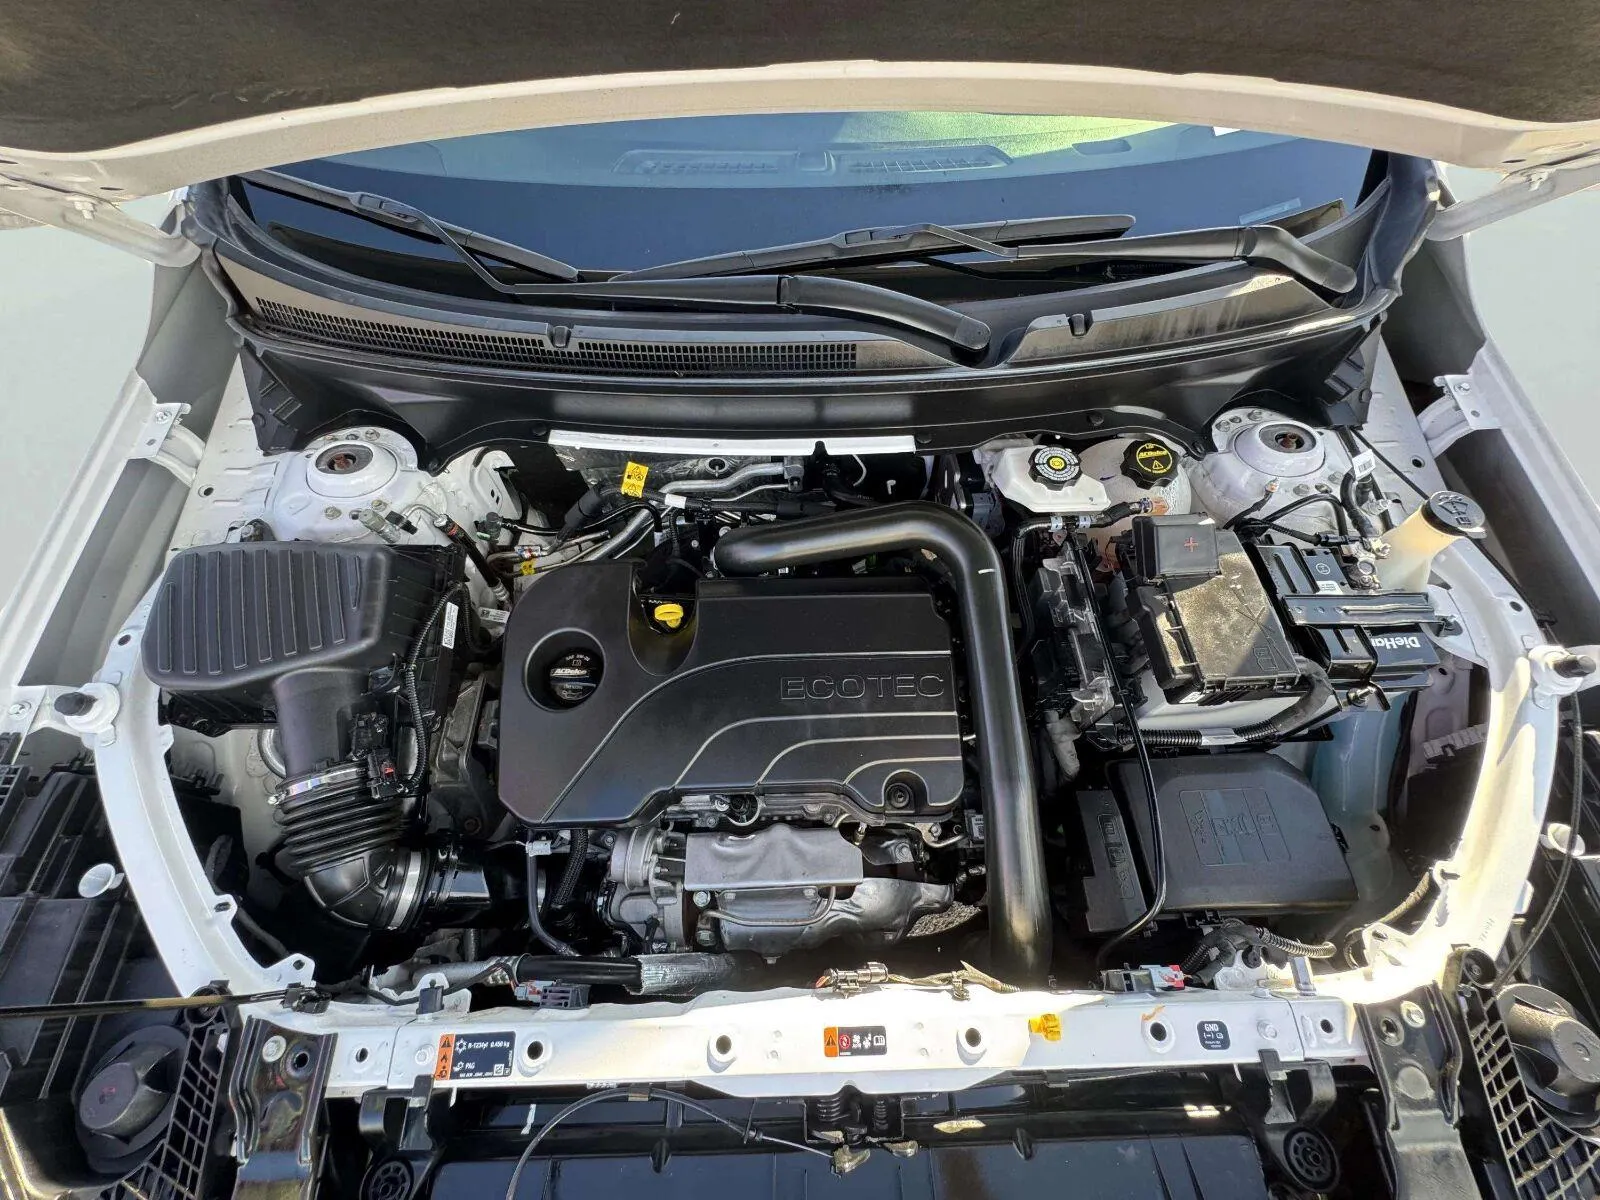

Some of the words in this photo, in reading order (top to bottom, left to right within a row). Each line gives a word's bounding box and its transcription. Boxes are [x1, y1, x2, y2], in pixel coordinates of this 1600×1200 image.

[1371, 636, 1421, 649] DieHar
[553, 668, 588, 676] ACDelco
[780, 673, 945, 700] ECOTEC
[1204, 1023, 1219, 1031] GND
